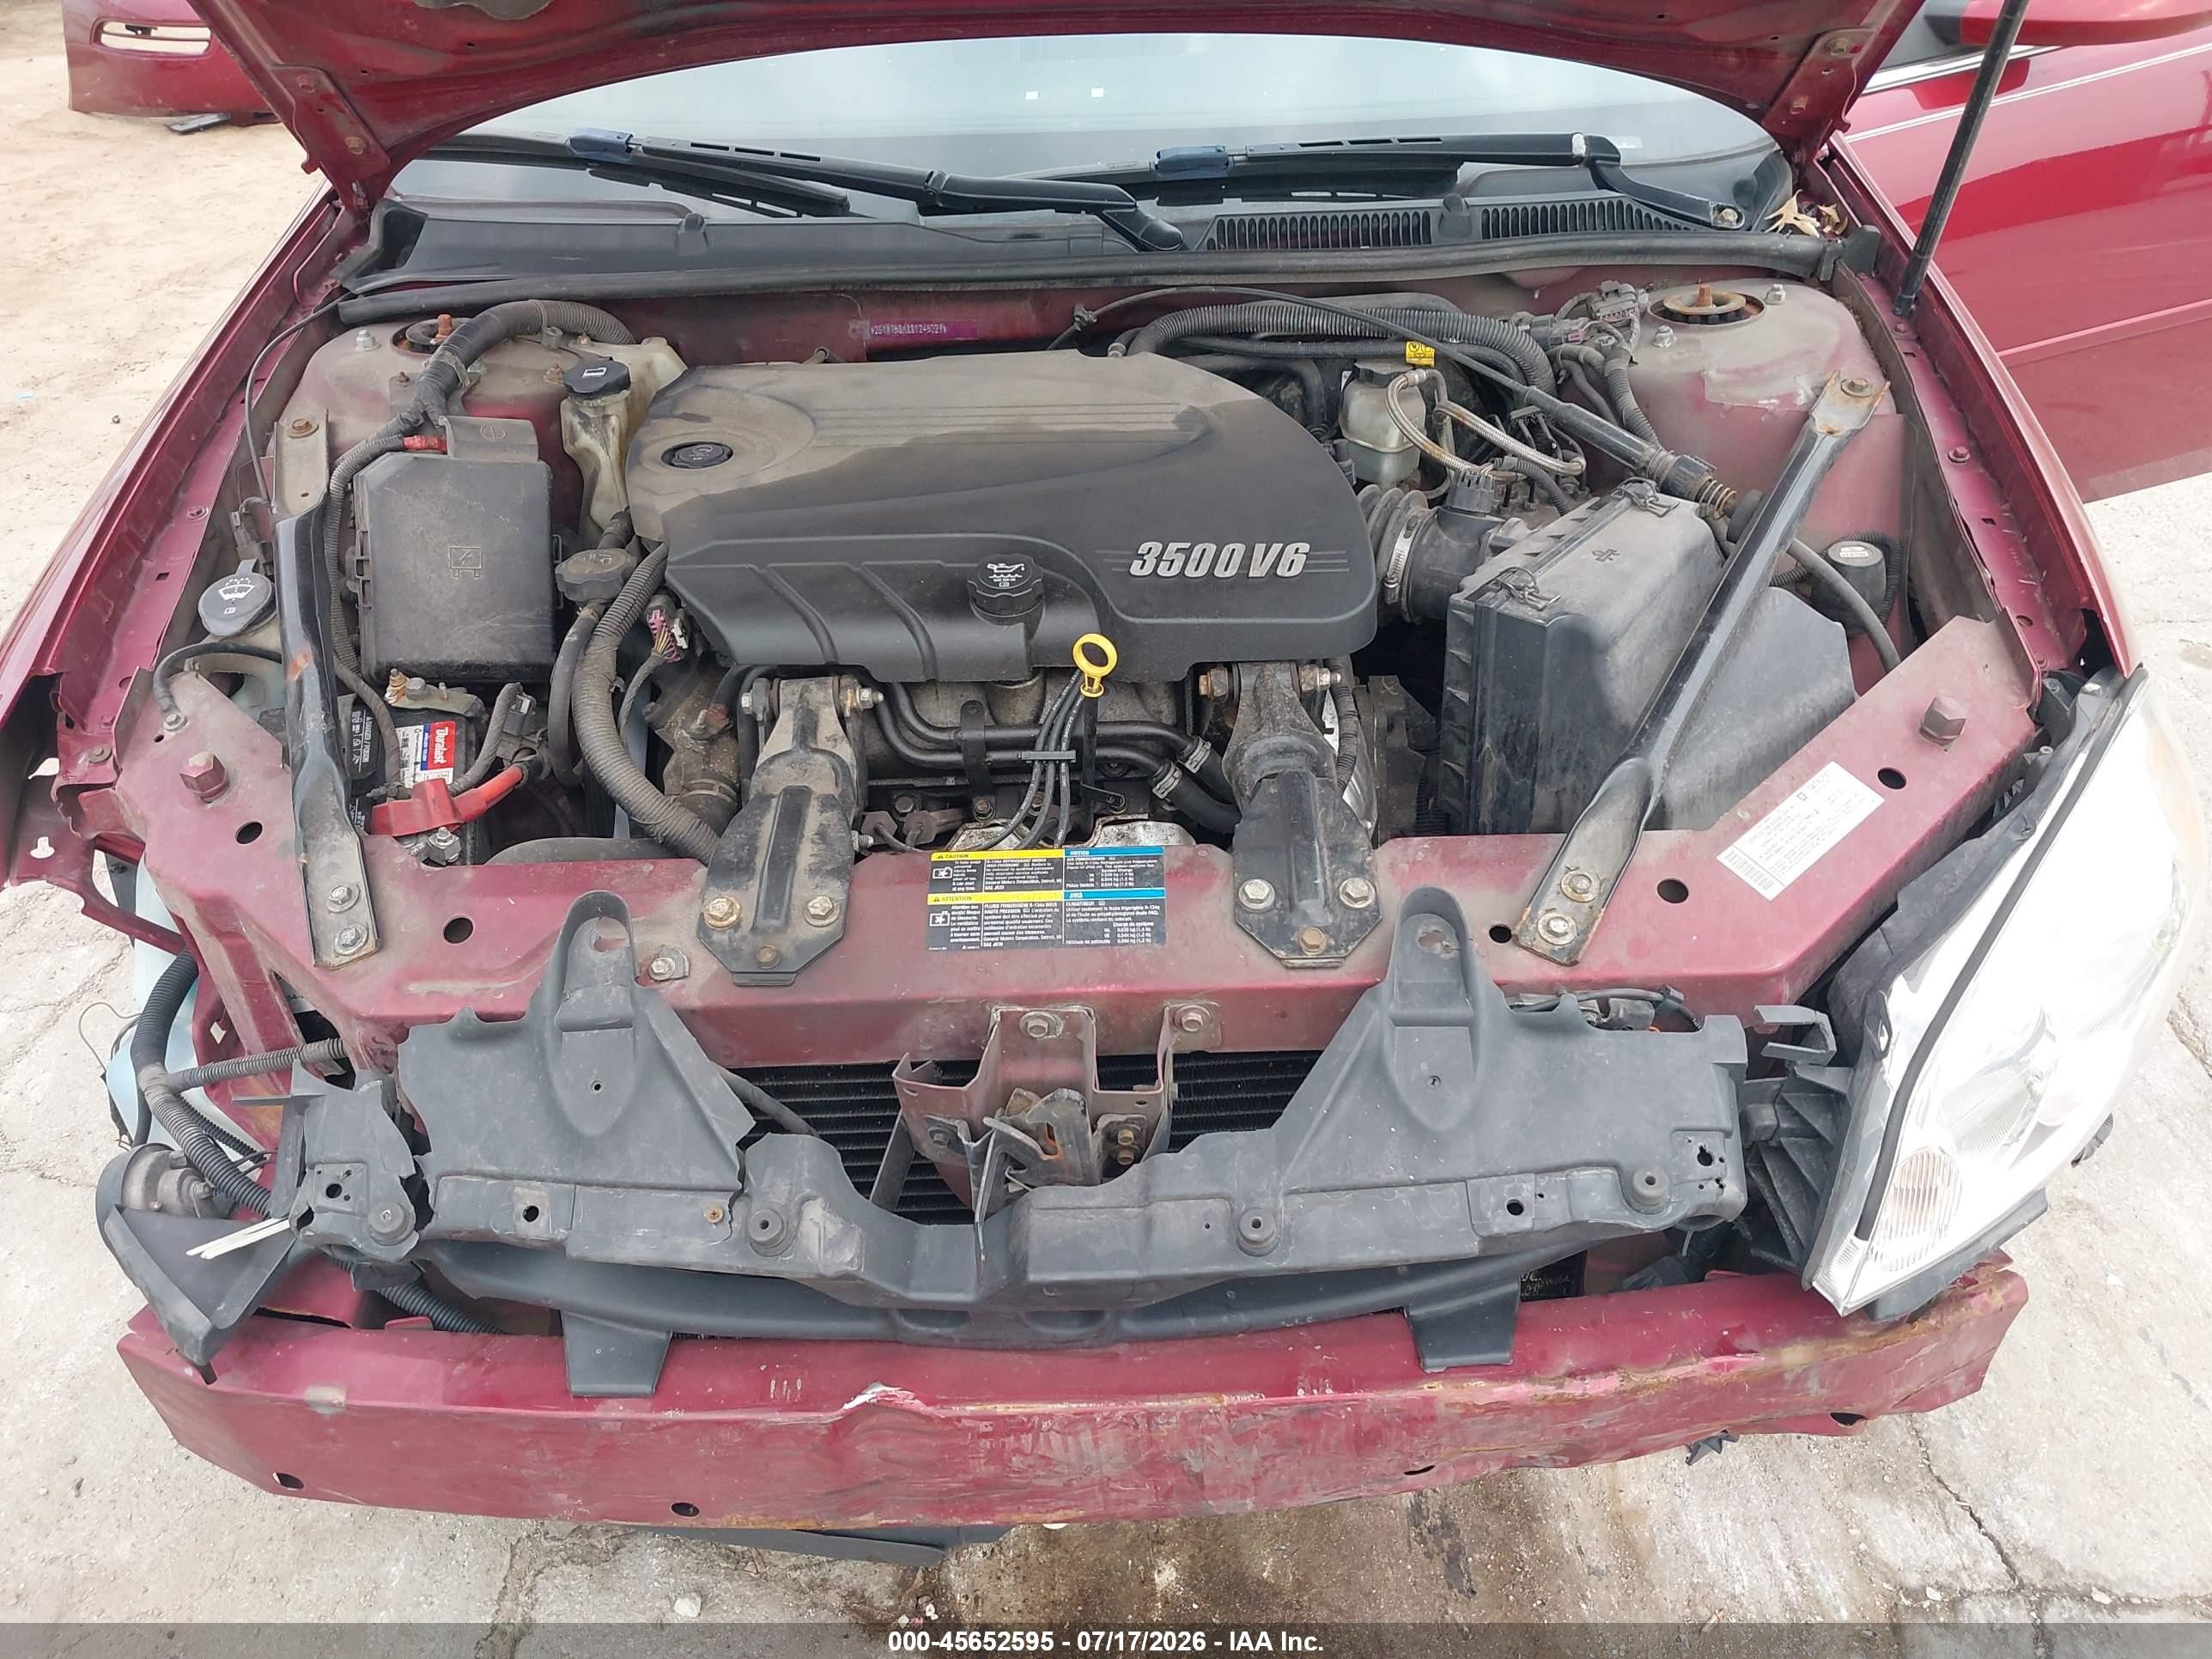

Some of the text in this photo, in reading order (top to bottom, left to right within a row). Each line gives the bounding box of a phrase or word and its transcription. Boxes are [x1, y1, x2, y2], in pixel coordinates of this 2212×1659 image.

[1129, 542, 1310, 578] 3500 V6
[434, 726, 448, 764] Duralast
